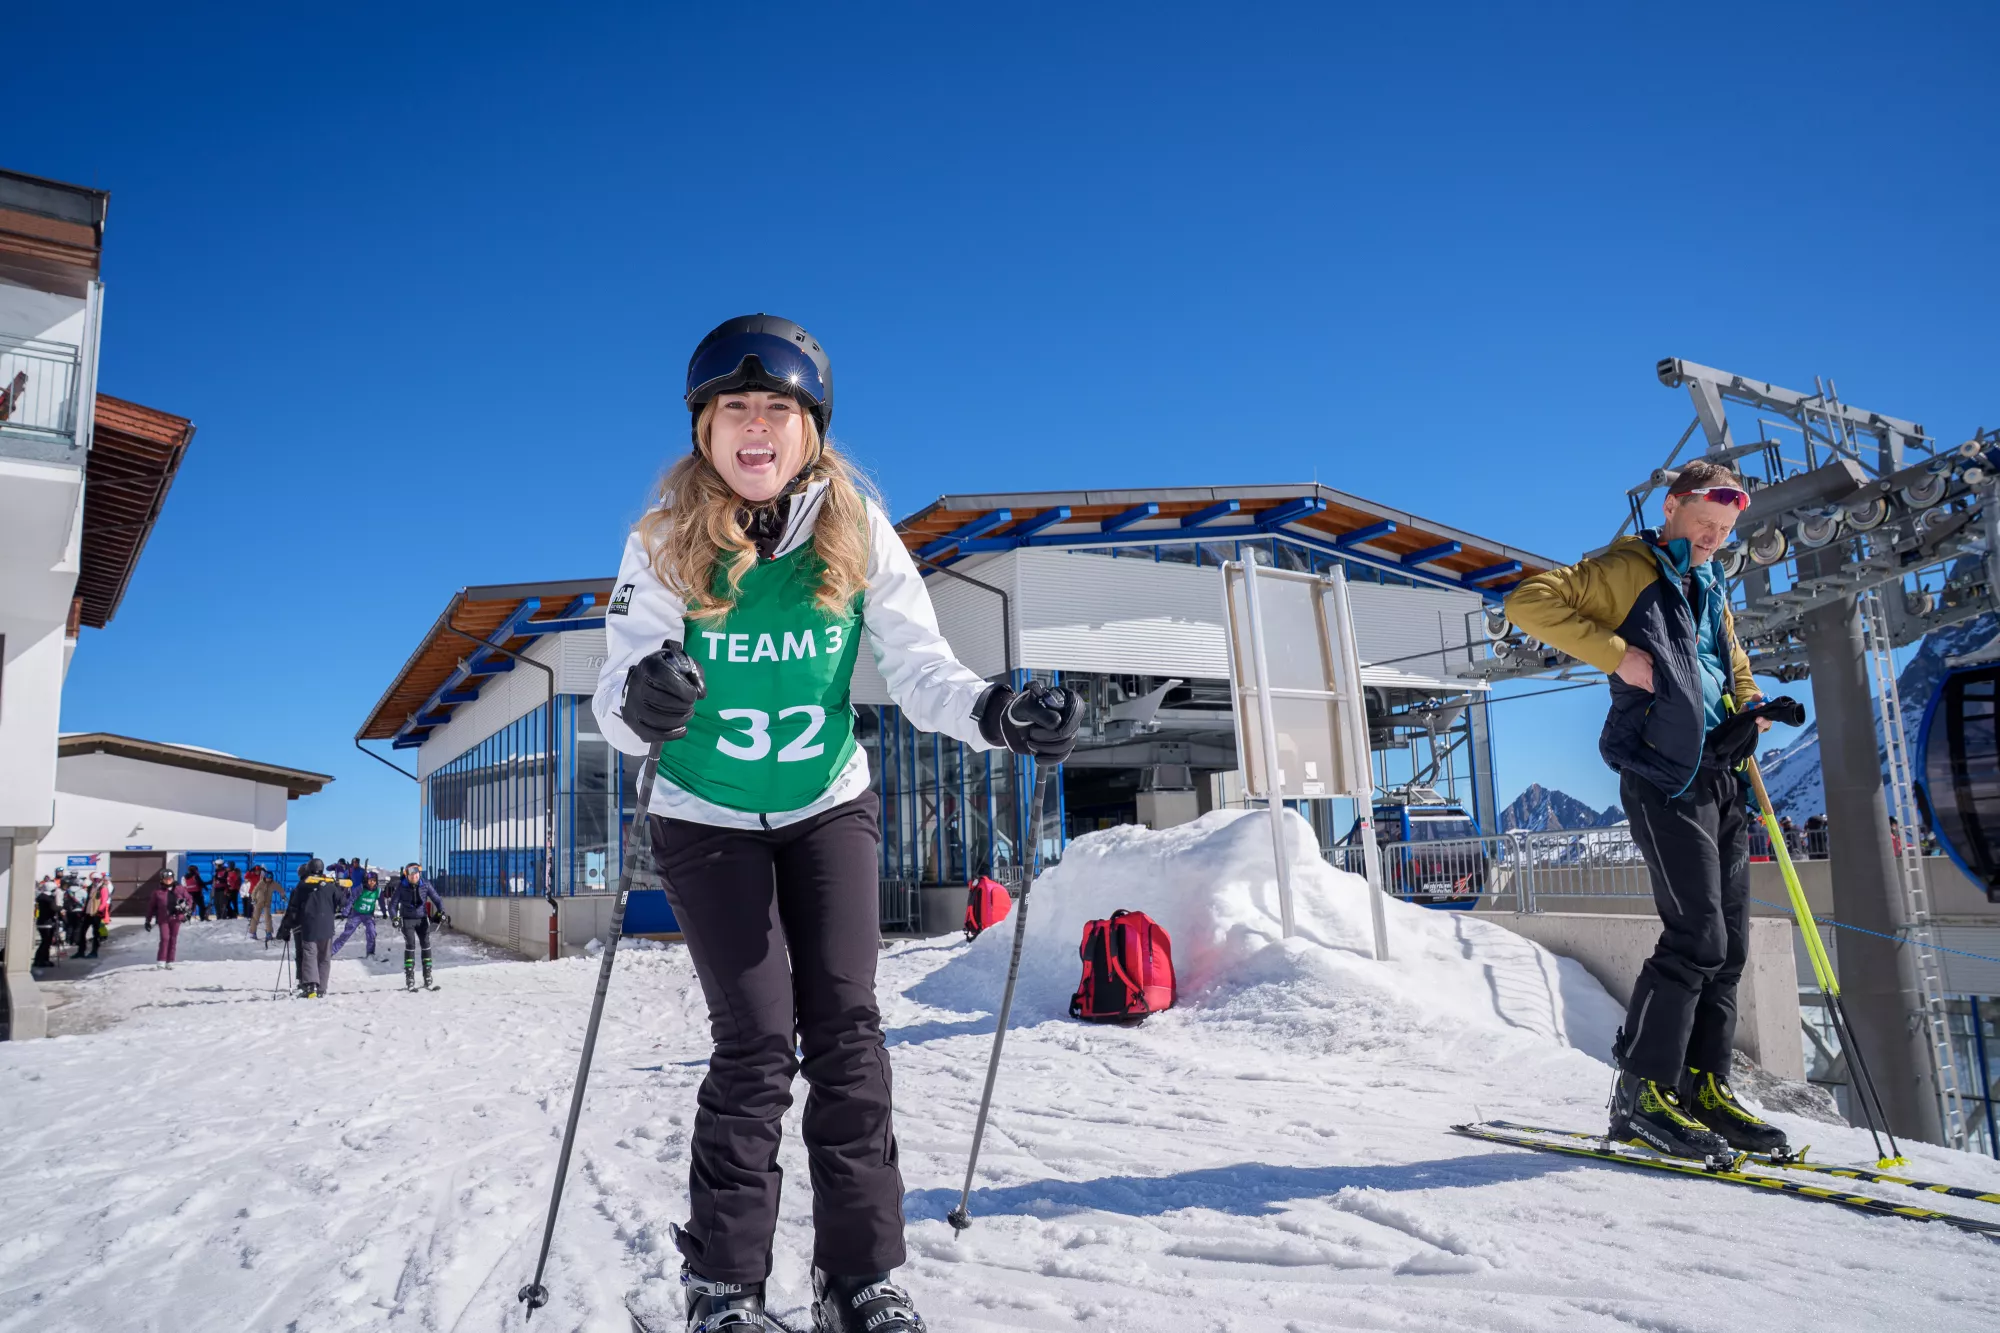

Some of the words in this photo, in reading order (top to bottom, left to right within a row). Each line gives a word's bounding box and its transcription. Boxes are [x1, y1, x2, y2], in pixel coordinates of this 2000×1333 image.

[701, 629, 817, 663] TEAM
[825, 625, 843, 654] 3
[716, 704, 826, 762] 32
[1629, 1121, 1671, 1152] SCARPA
